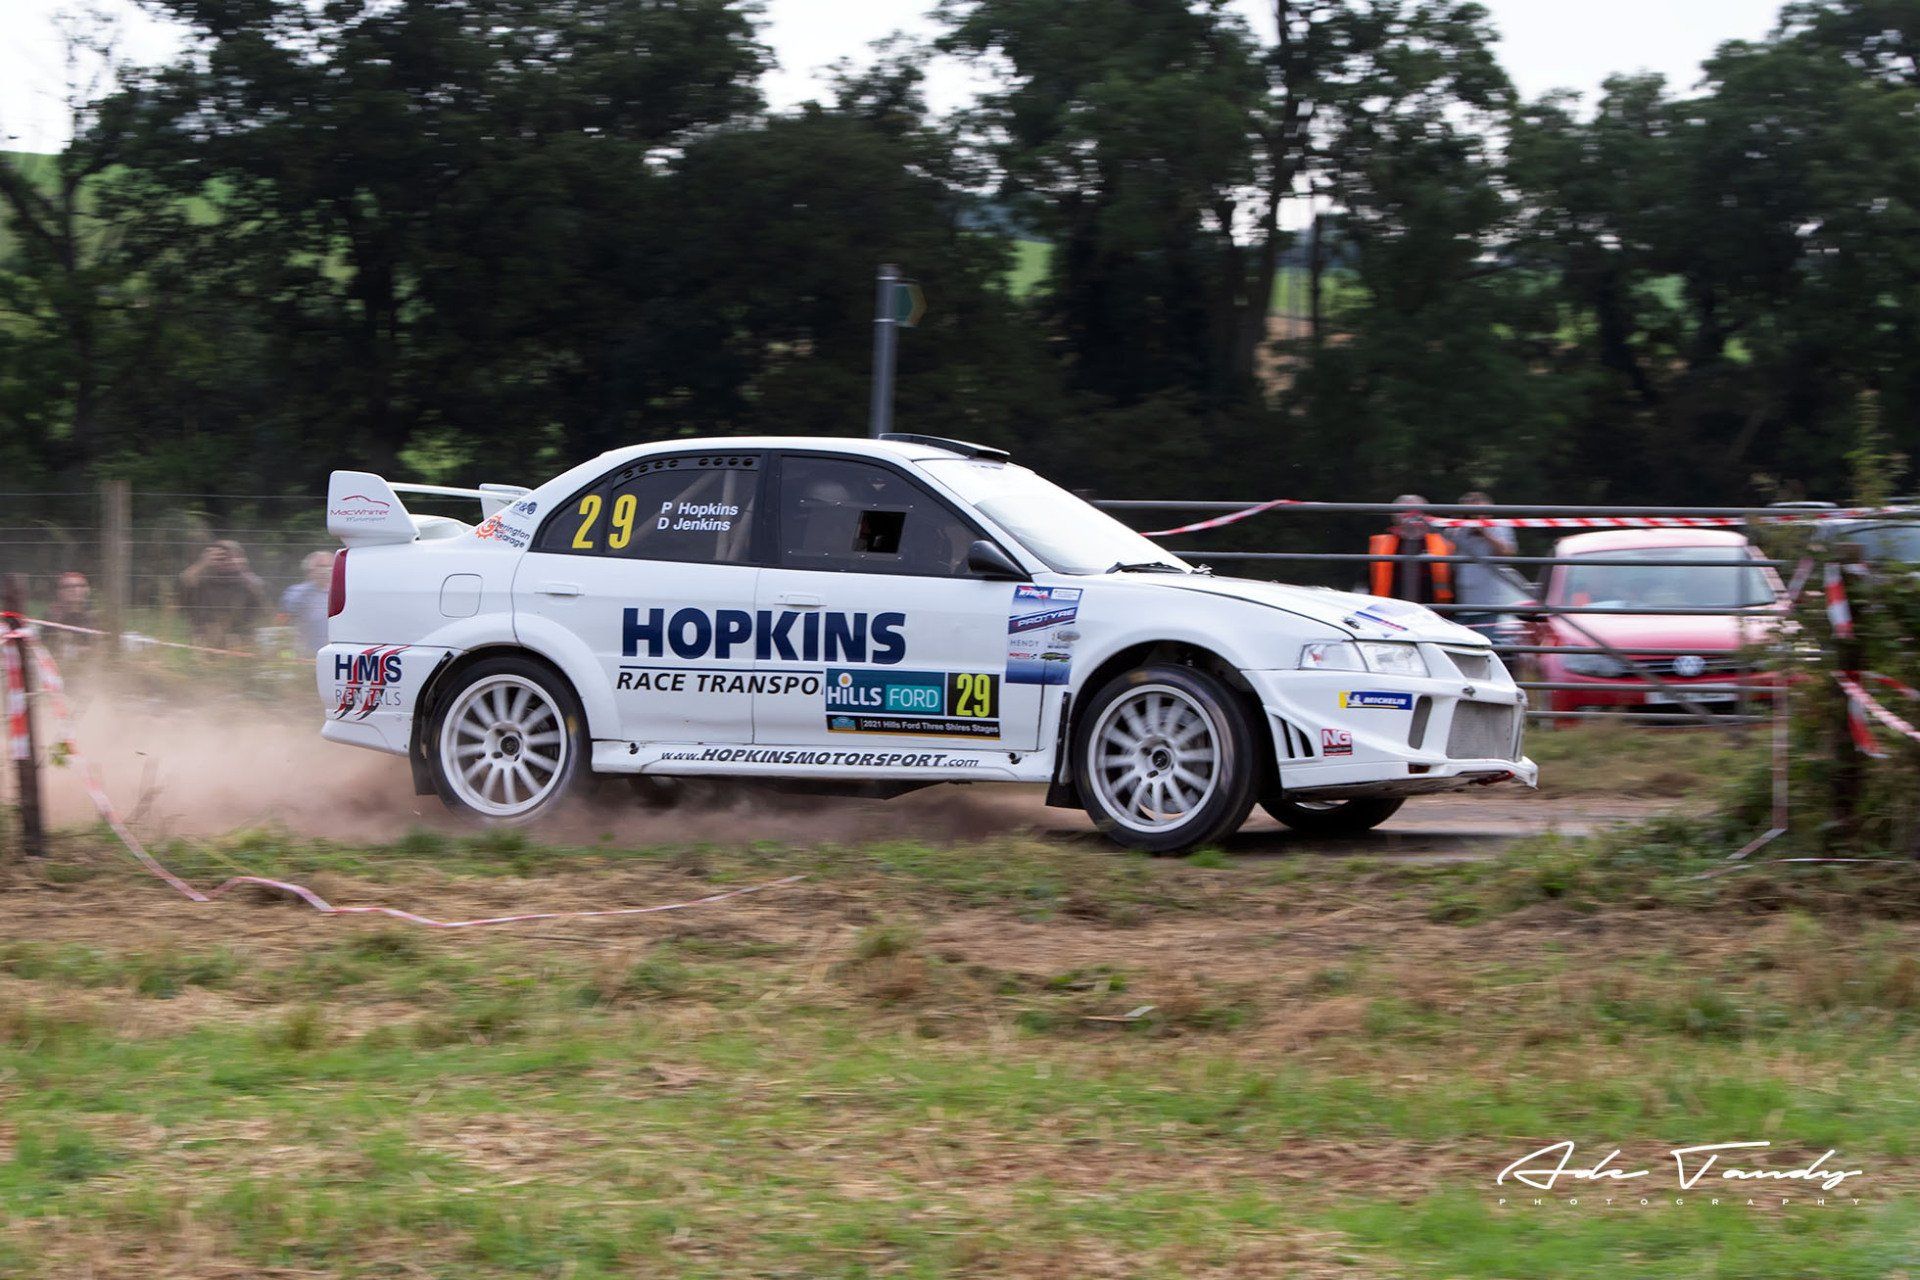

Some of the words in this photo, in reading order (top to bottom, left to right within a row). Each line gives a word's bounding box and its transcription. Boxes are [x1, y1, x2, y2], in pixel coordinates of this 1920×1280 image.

[661, 502, 673, 514] P
[678, 502, 739, 517] Hopkins
[572, 494, 637, 549] 29
[657, 518, 670, 530] D
[673, 518, 731, 532] Jenkins
[1018, 609, 1075, 627] PROTYRE
[622, 607, 907, 665] HOPKINS
[335, 654, 402, 683] HMS
[616, 672, 686, 691] RACE
[697, 674, 824, 695] TRANSPO
[335, 689, 402, 706] RENTALS
[889, 688, 939, 708] FORD
[956, 673, 991, 717] 29
[1363, 696, 1407, 705] MICHELIN
[863, 720, 881, 728] 2021
[883, 721, 900, 730] Hills
[903, 721, 921, 730] Ford
[922, 722, 945, 731] Three
[945, 723, 970, 732] Shires
[972, 724, 998, 734] Stages
[1322, 730, 1351, 746] NG
[661, 749, 979, 767] www.HOPKINSMOTORSPORT.com
